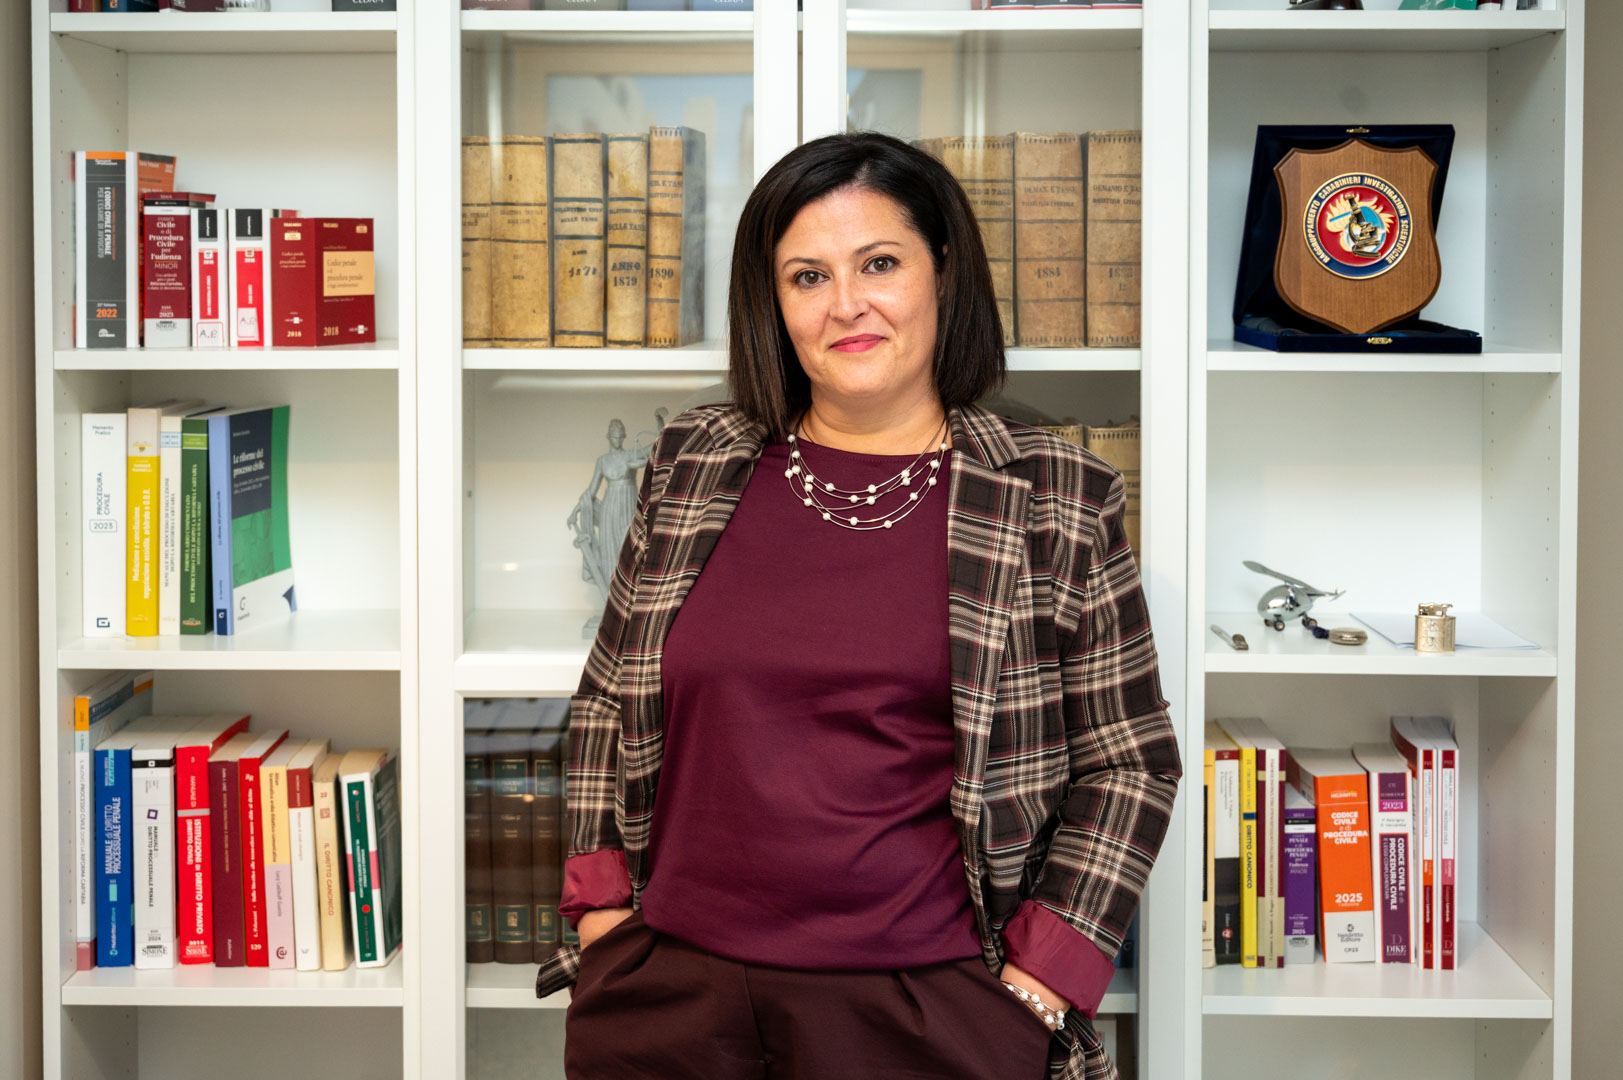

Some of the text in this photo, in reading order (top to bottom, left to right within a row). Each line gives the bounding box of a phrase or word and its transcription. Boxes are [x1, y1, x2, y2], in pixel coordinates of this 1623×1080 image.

[104, 191, 112, 210] CODICI
[104, 211, 112, 228] CIVILE
[1307, 176, 1408, 264] RAGGRUPPAMENTO CARABINIERI INVESTIGAZIONI SCIENTIFICHE
[149, 234, 184, 242] Procedura
[104, 234, 112, 256] PENALE
[151, 252, 182, 261] l'udienza
[612, 262, 641, 271] ANNO
[650, 267, 674, 279] 1890
[613, 276, 638, 287] 1879
[97, 309, 118, 318] 2022
[324, 326, 340, 337] 2018
[1331, 811, 1359, 819] CODICE
[1333, 818, 1357, 826] CIVILE
[105, 805, 113, 874] MANUALE di DIRITTO
[112, 797, 121, 874] PROCESSUALE PENALE
[1323, 830, 1369, 839] PROCEDURA
[1334, 837, 1358, 845] CIVILE
[1397, 838, 1405, 866] CODICE
[1389, 838, 1398, 911] PROCEDURA CIVILE
[1398, 867, 1406, 892] CIVILE
[195, 872, 203, 900] DIRITTO
[327, 879, 335, 916] CANONICO
[1335, 892, 1363, 903] 2025
[196, 902, 204, 934] PRIVATO
[1386, 945, 1407, 953] DIKE
